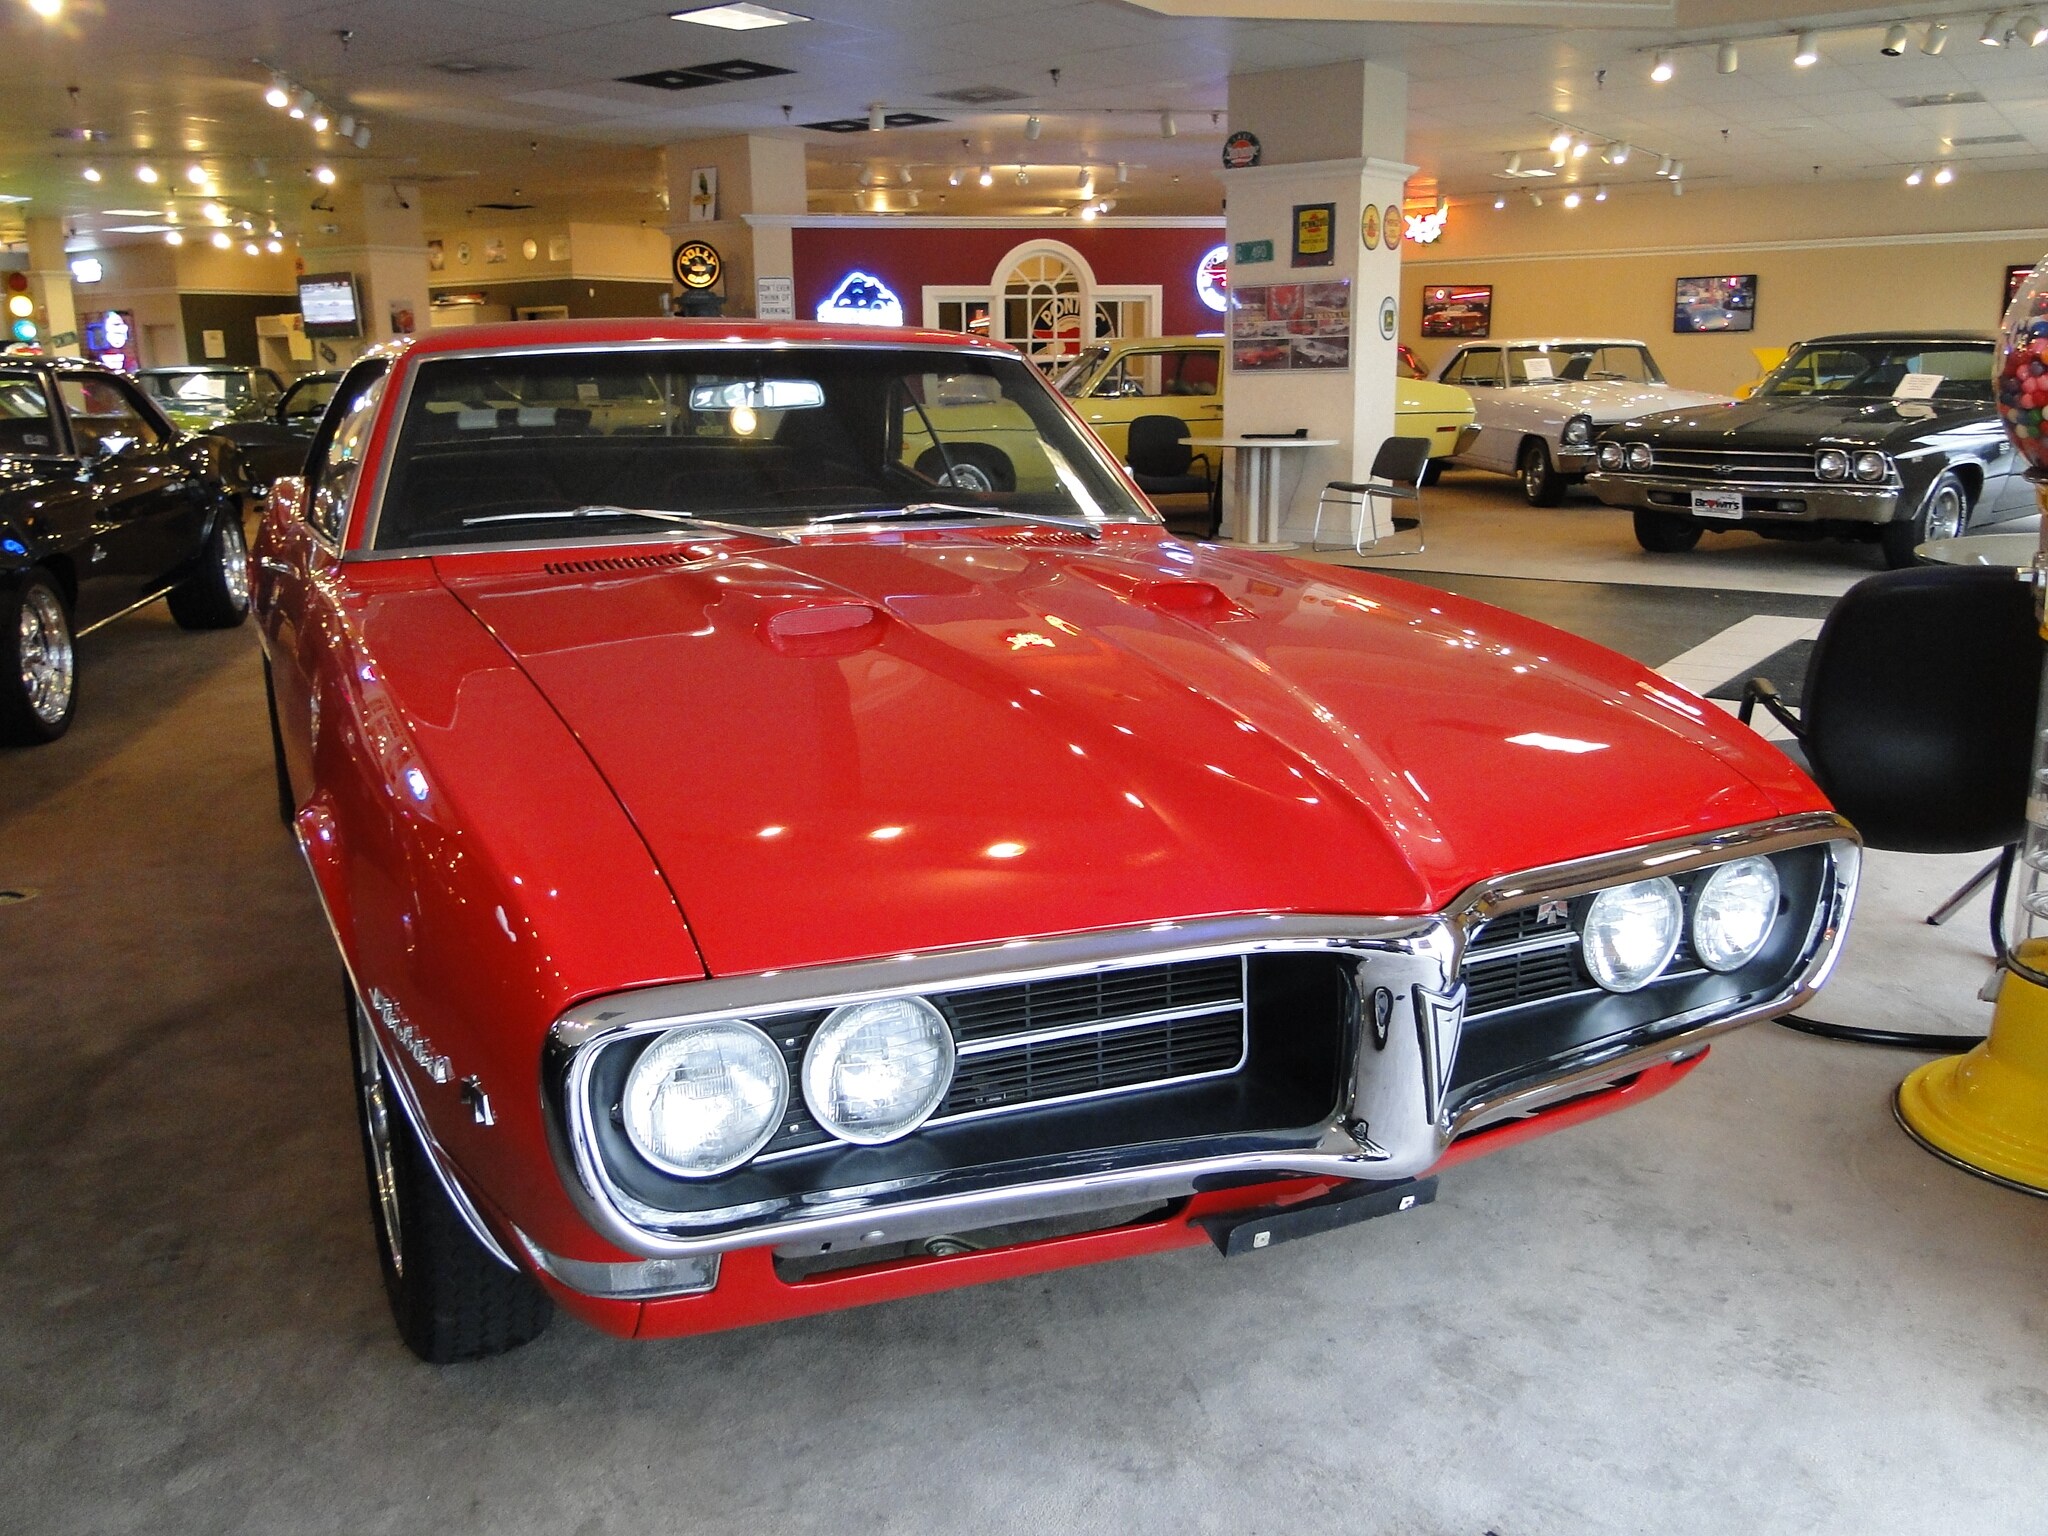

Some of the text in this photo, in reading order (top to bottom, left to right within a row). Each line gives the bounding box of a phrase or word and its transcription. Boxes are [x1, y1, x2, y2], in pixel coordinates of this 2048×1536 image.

[681, 247, 716, 266] POLLY
[761, 307, 791, 315] PARKING
[1711, 464, 1733, 473] SS
